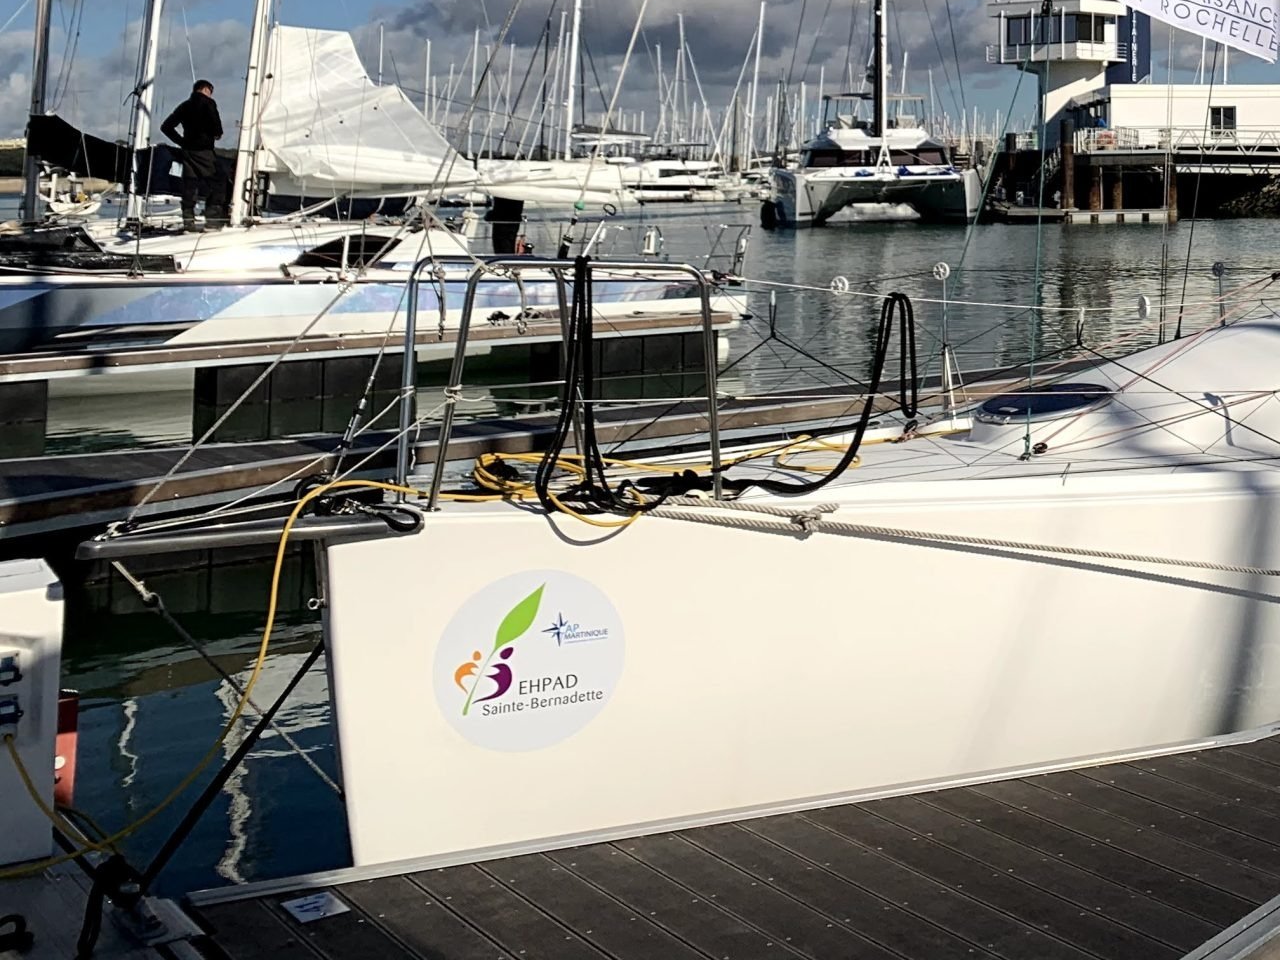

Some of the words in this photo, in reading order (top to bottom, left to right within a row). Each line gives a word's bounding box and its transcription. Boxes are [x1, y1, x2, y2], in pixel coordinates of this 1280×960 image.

[563, 628, 609, 640] MARTINIQUE
[518, 673, 578, 696] EHPAD
[482, 689, 603, 717] Sainte-Bernadette
